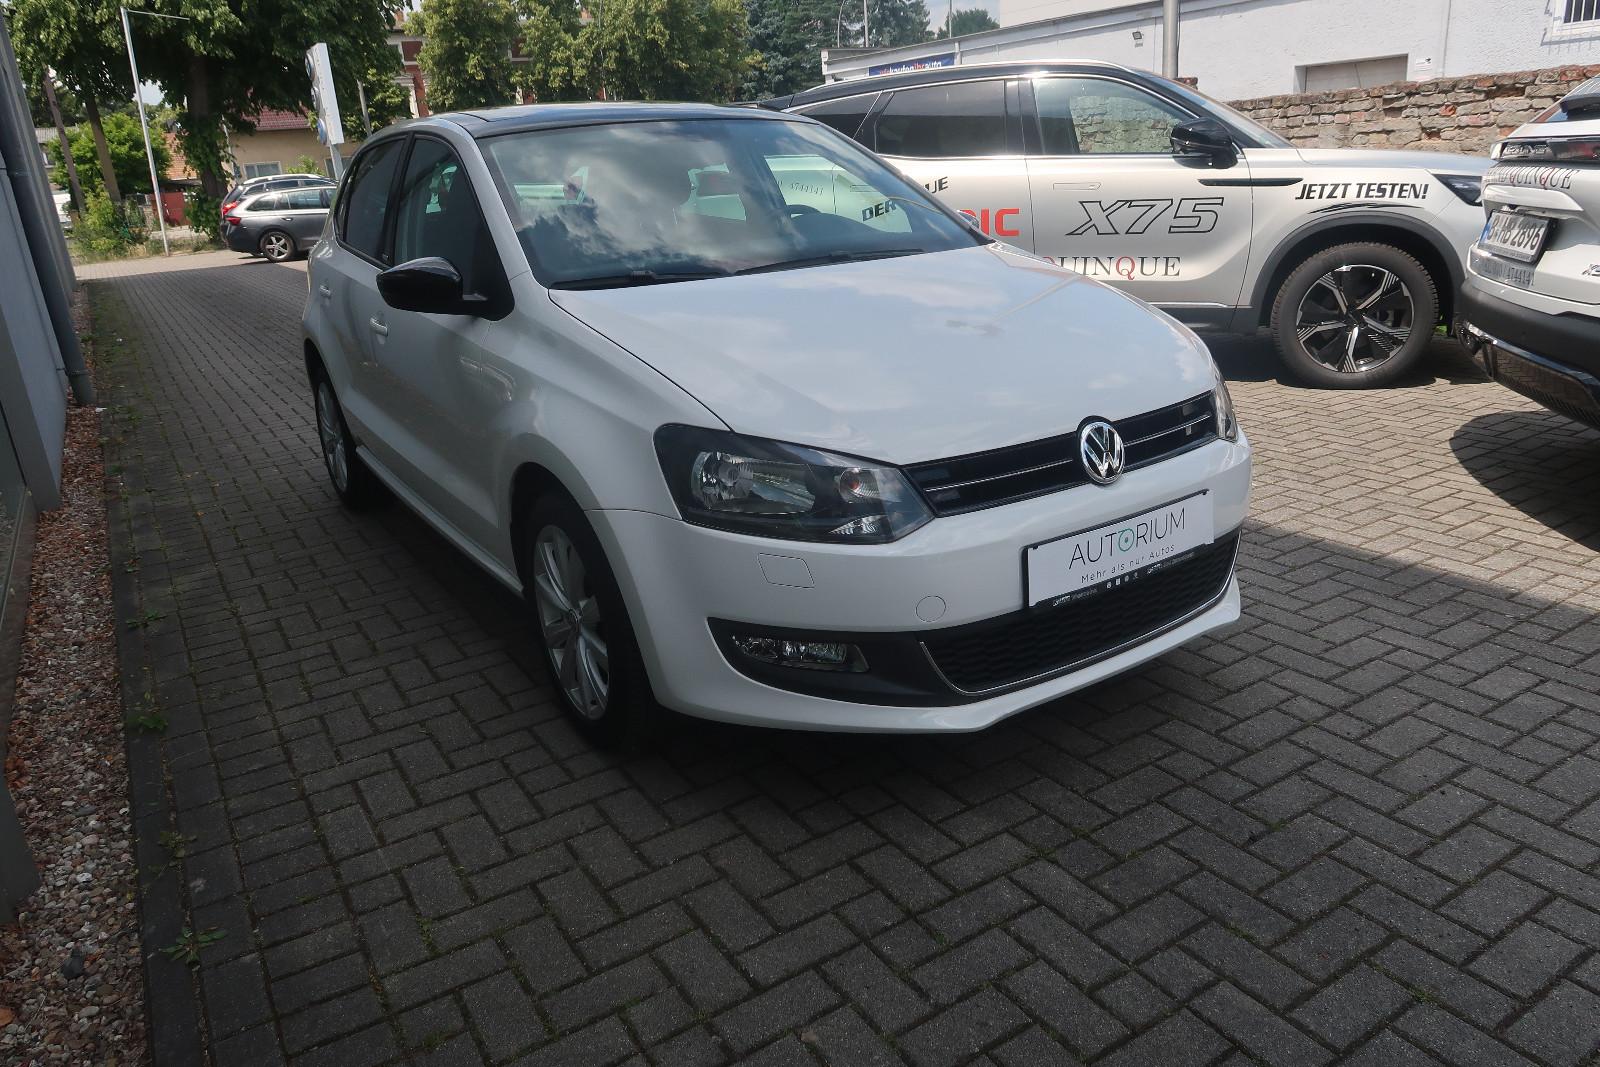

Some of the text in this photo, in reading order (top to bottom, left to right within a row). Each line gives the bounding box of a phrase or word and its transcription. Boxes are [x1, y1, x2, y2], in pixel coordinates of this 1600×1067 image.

[1295, 182, 1430, 200] JETZT TESTEN!
[1065, 197, 1224, 236] X75
[1043, 256, 1182, 281] UINQUE
[1068, 506, 1186, 571] AUTORIUM
[1081, 569, 1107, 584] Mehr
[1111, 562, 1126, 574] als
[1129, 555, 1145, 567] nur
[1147, 543, 1176, 561] Autos
